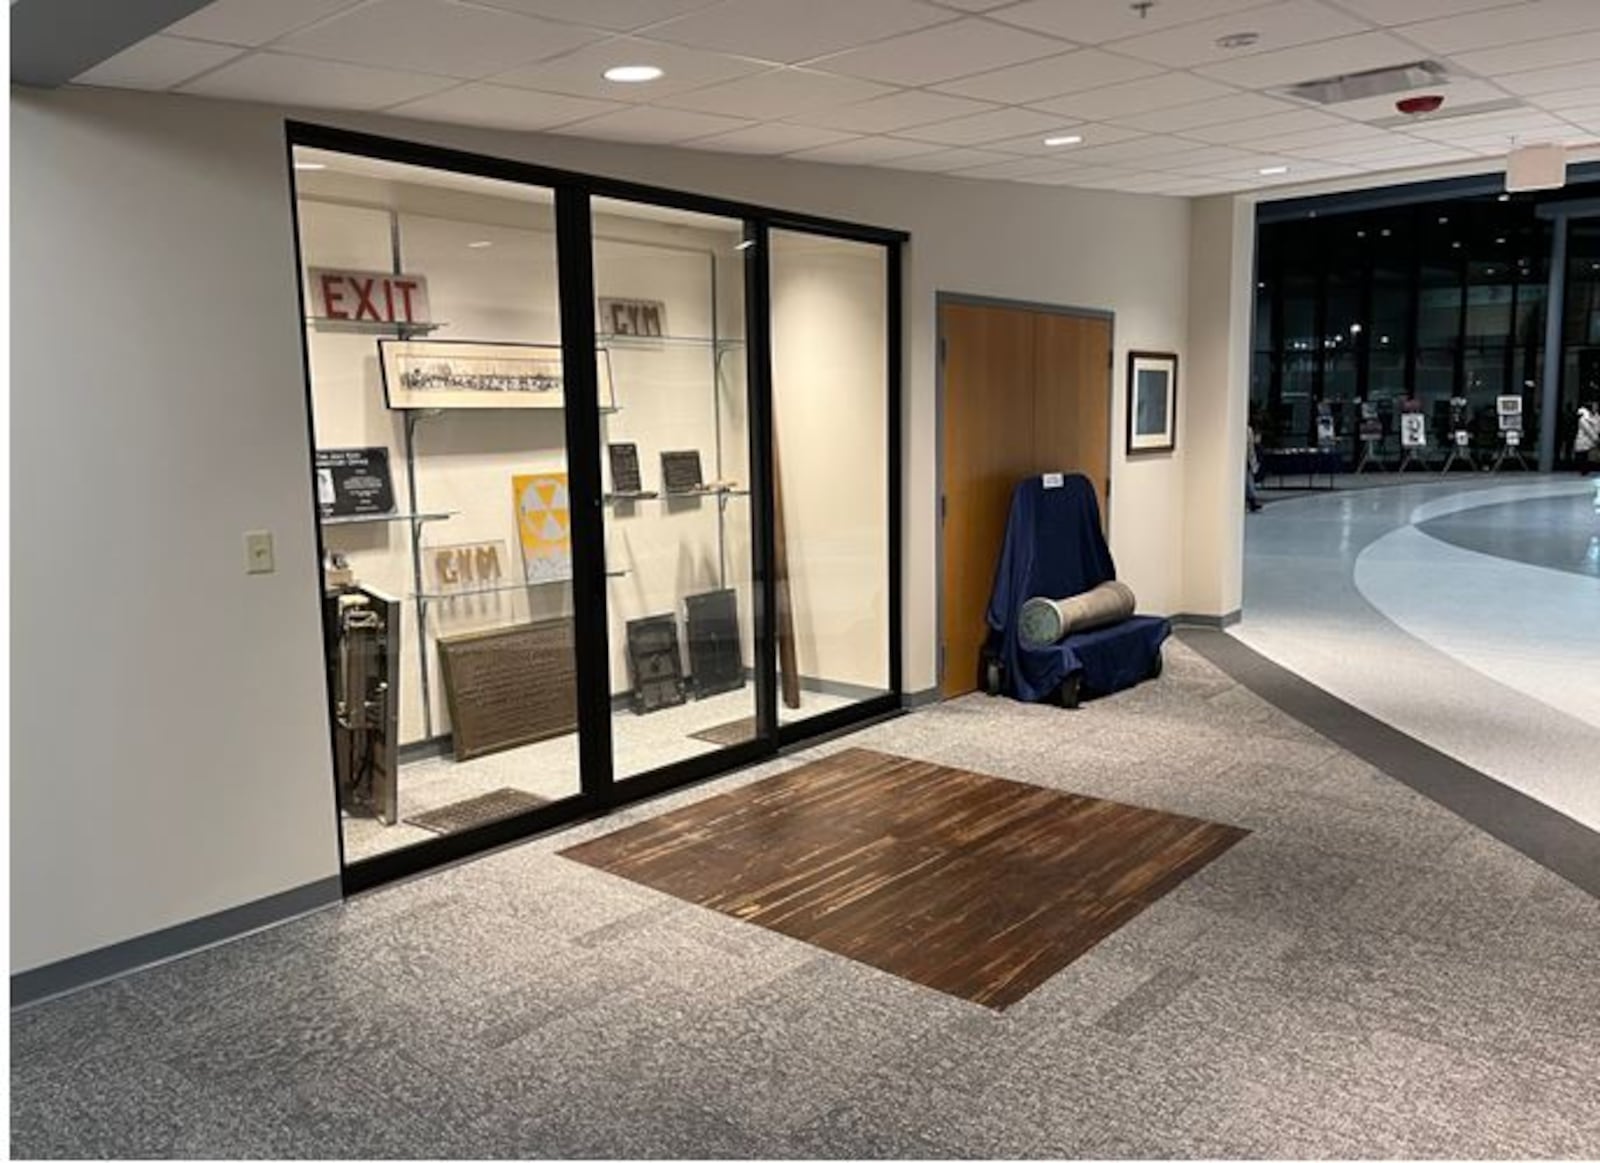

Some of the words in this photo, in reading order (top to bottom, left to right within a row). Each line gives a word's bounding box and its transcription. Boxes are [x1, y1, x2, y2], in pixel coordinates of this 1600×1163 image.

[321, 275, 416, 324] EXIT
[611, 304, 661, 336] GYM
[436, 546, 501, 584] GYM
